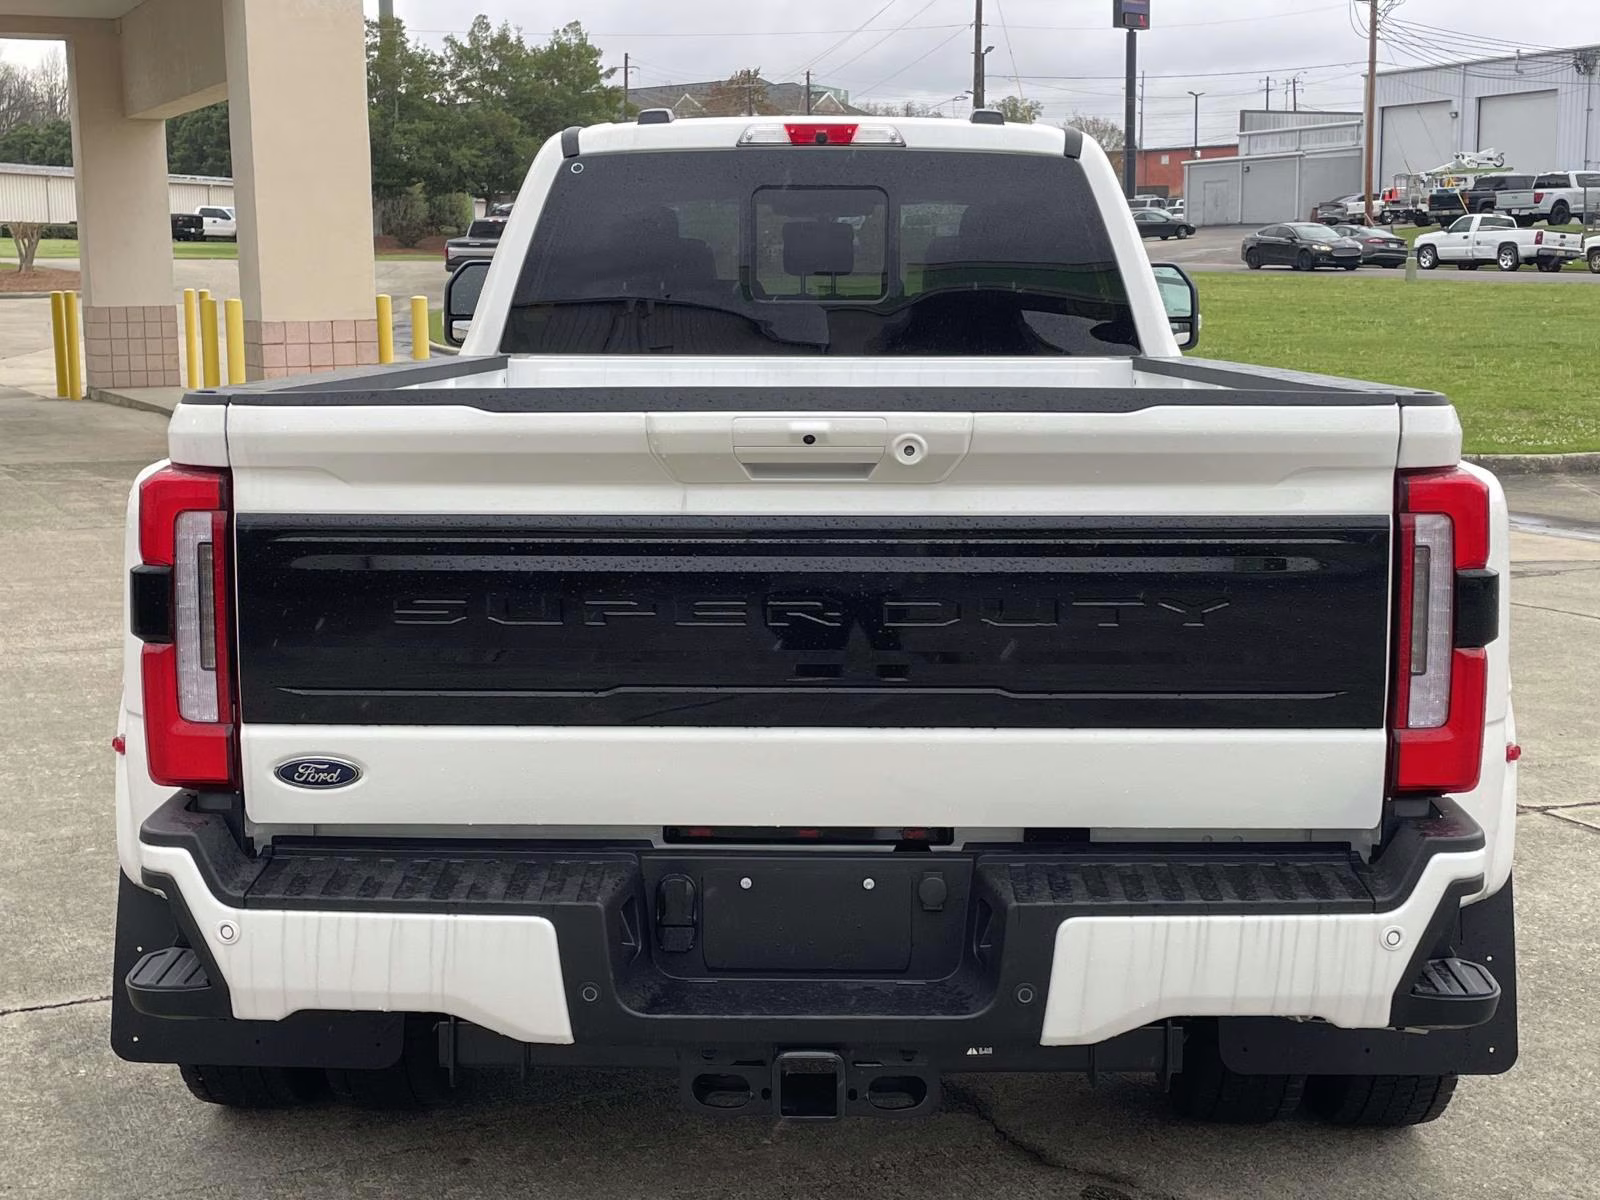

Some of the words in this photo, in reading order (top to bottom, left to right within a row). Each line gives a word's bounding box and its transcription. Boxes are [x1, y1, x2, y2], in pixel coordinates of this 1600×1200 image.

[392, 596, 842, 627] SUPER
[883, 597, 1231, 627] DUTY
[294, 763, 342, 783] Ford
